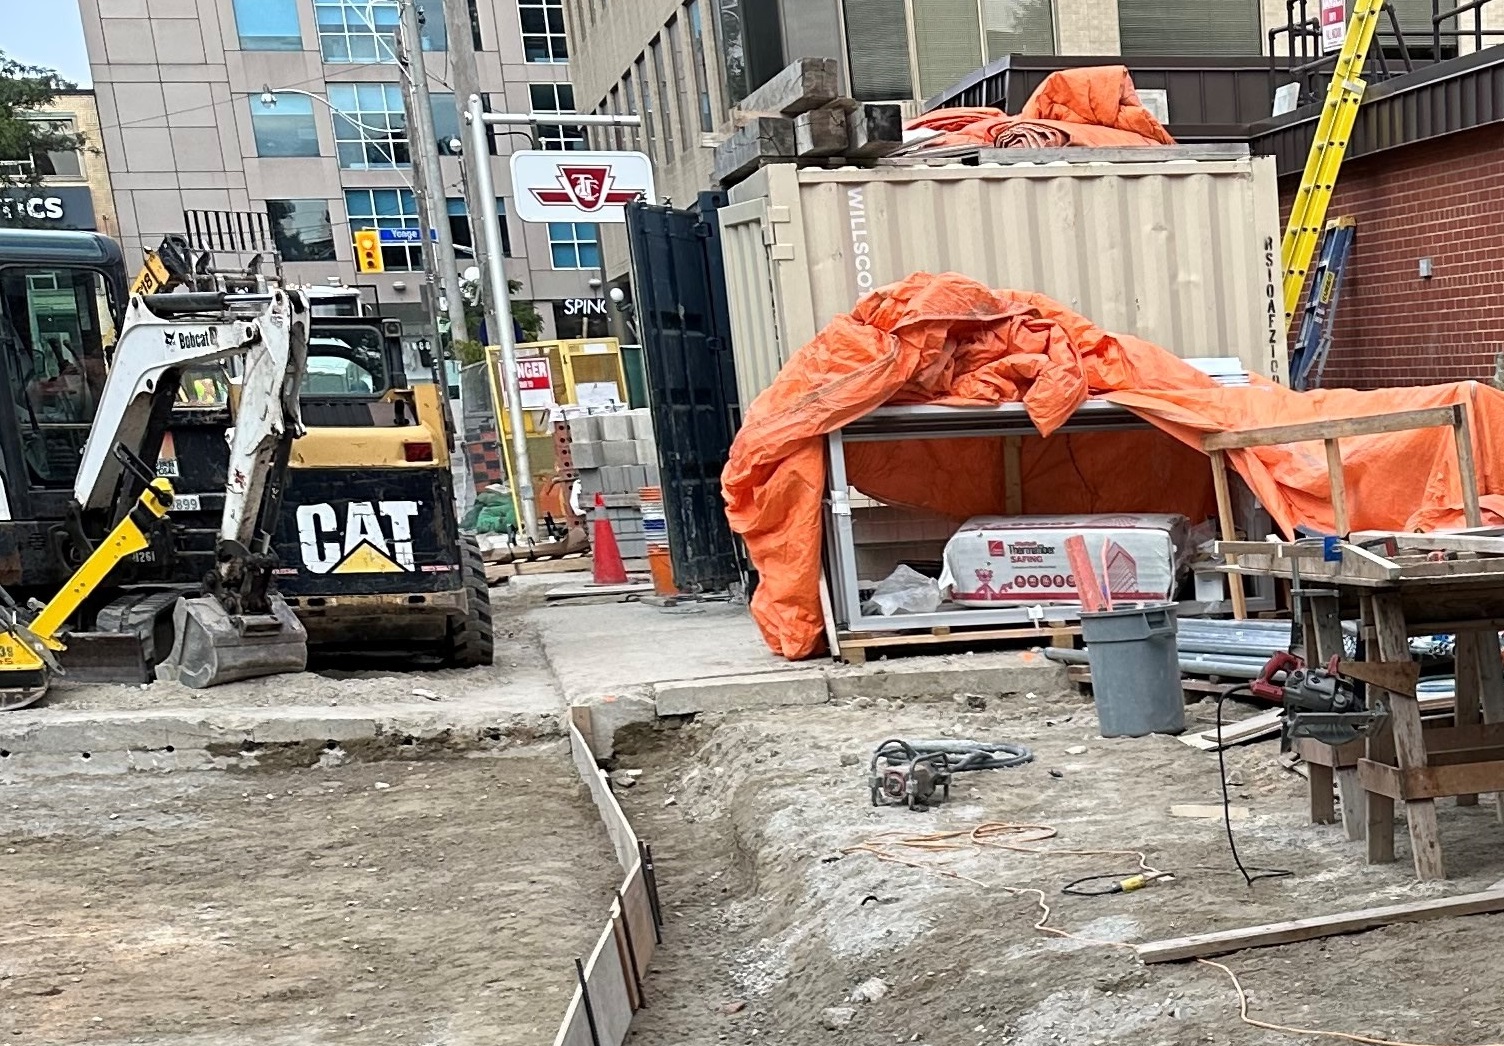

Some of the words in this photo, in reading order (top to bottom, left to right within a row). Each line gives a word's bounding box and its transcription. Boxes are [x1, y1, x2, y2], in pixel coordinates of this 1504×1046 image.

[390, 228, 418, 241] Yonge
[847, 186, 874, 297] WILLSCO
[178, 330, 210, 349] Bobcat
[517, 361, 548, 379] NGER
[296, 501, 419, 574] CAT
